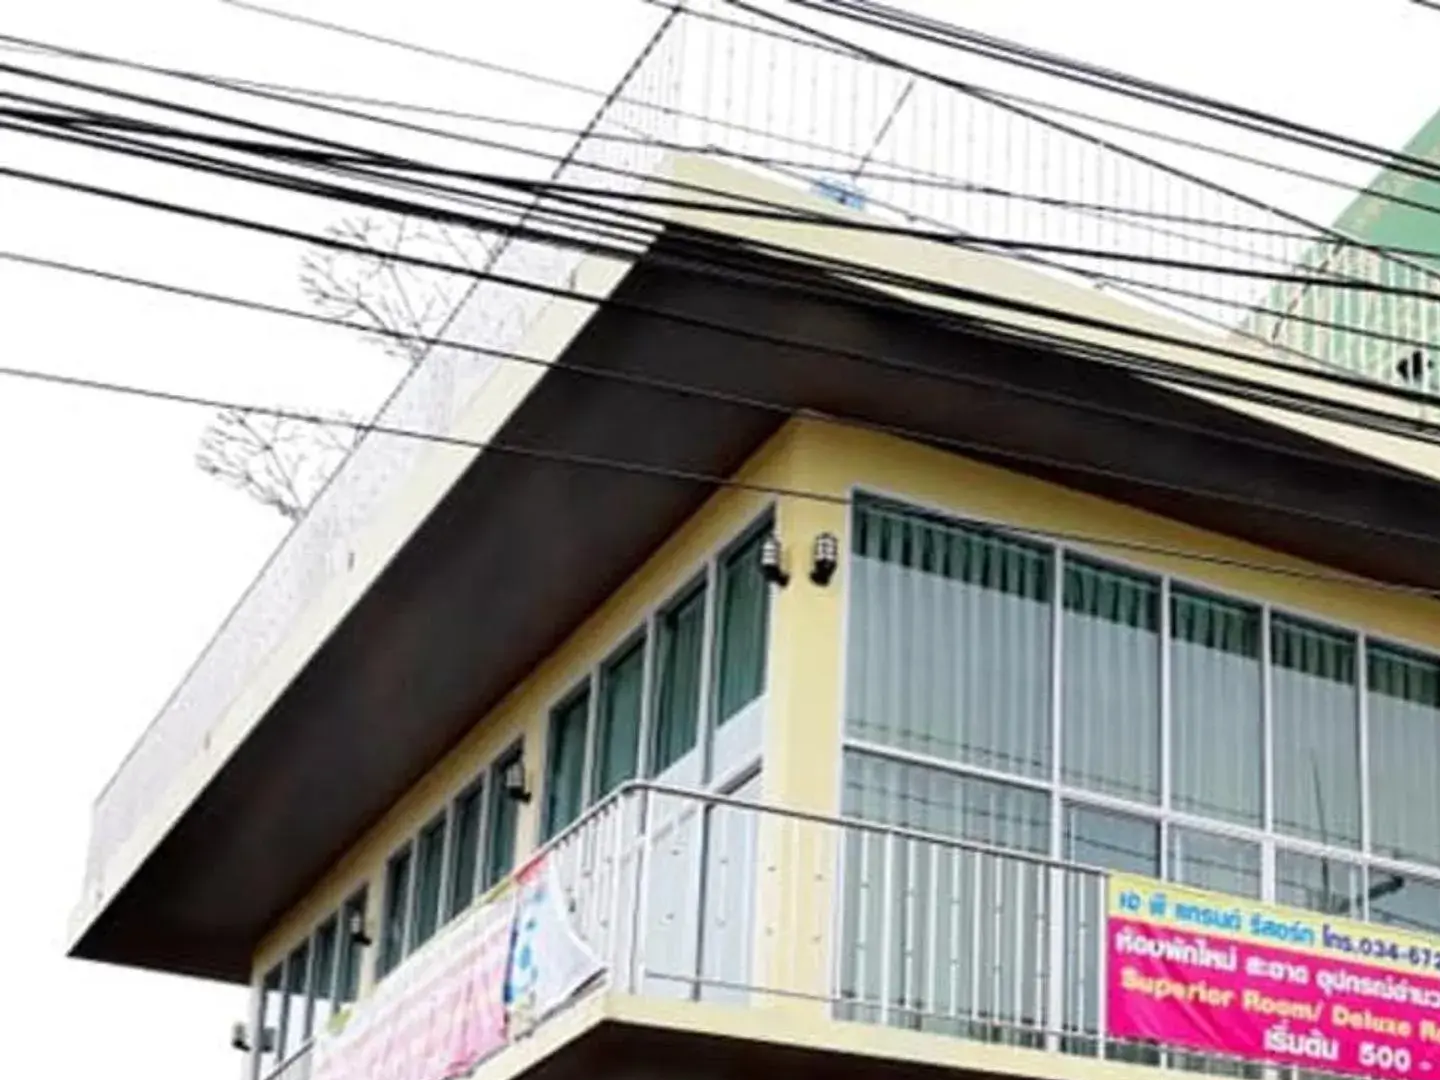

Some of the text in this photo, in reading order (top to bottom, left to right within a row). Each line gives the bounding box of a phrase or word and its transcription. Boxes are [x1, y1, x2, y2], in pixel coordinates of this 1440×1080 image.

[1115, 926, 1238, 972] ห้องพักใหม่
[1121, 965, 1235, 1008] Superior
[1332, 1004, 1412, 1038] Deluxe
[1264, 1017, 1339, 1061] เริ่มต้น
[1359, 1041, 1412, 1072] 500
